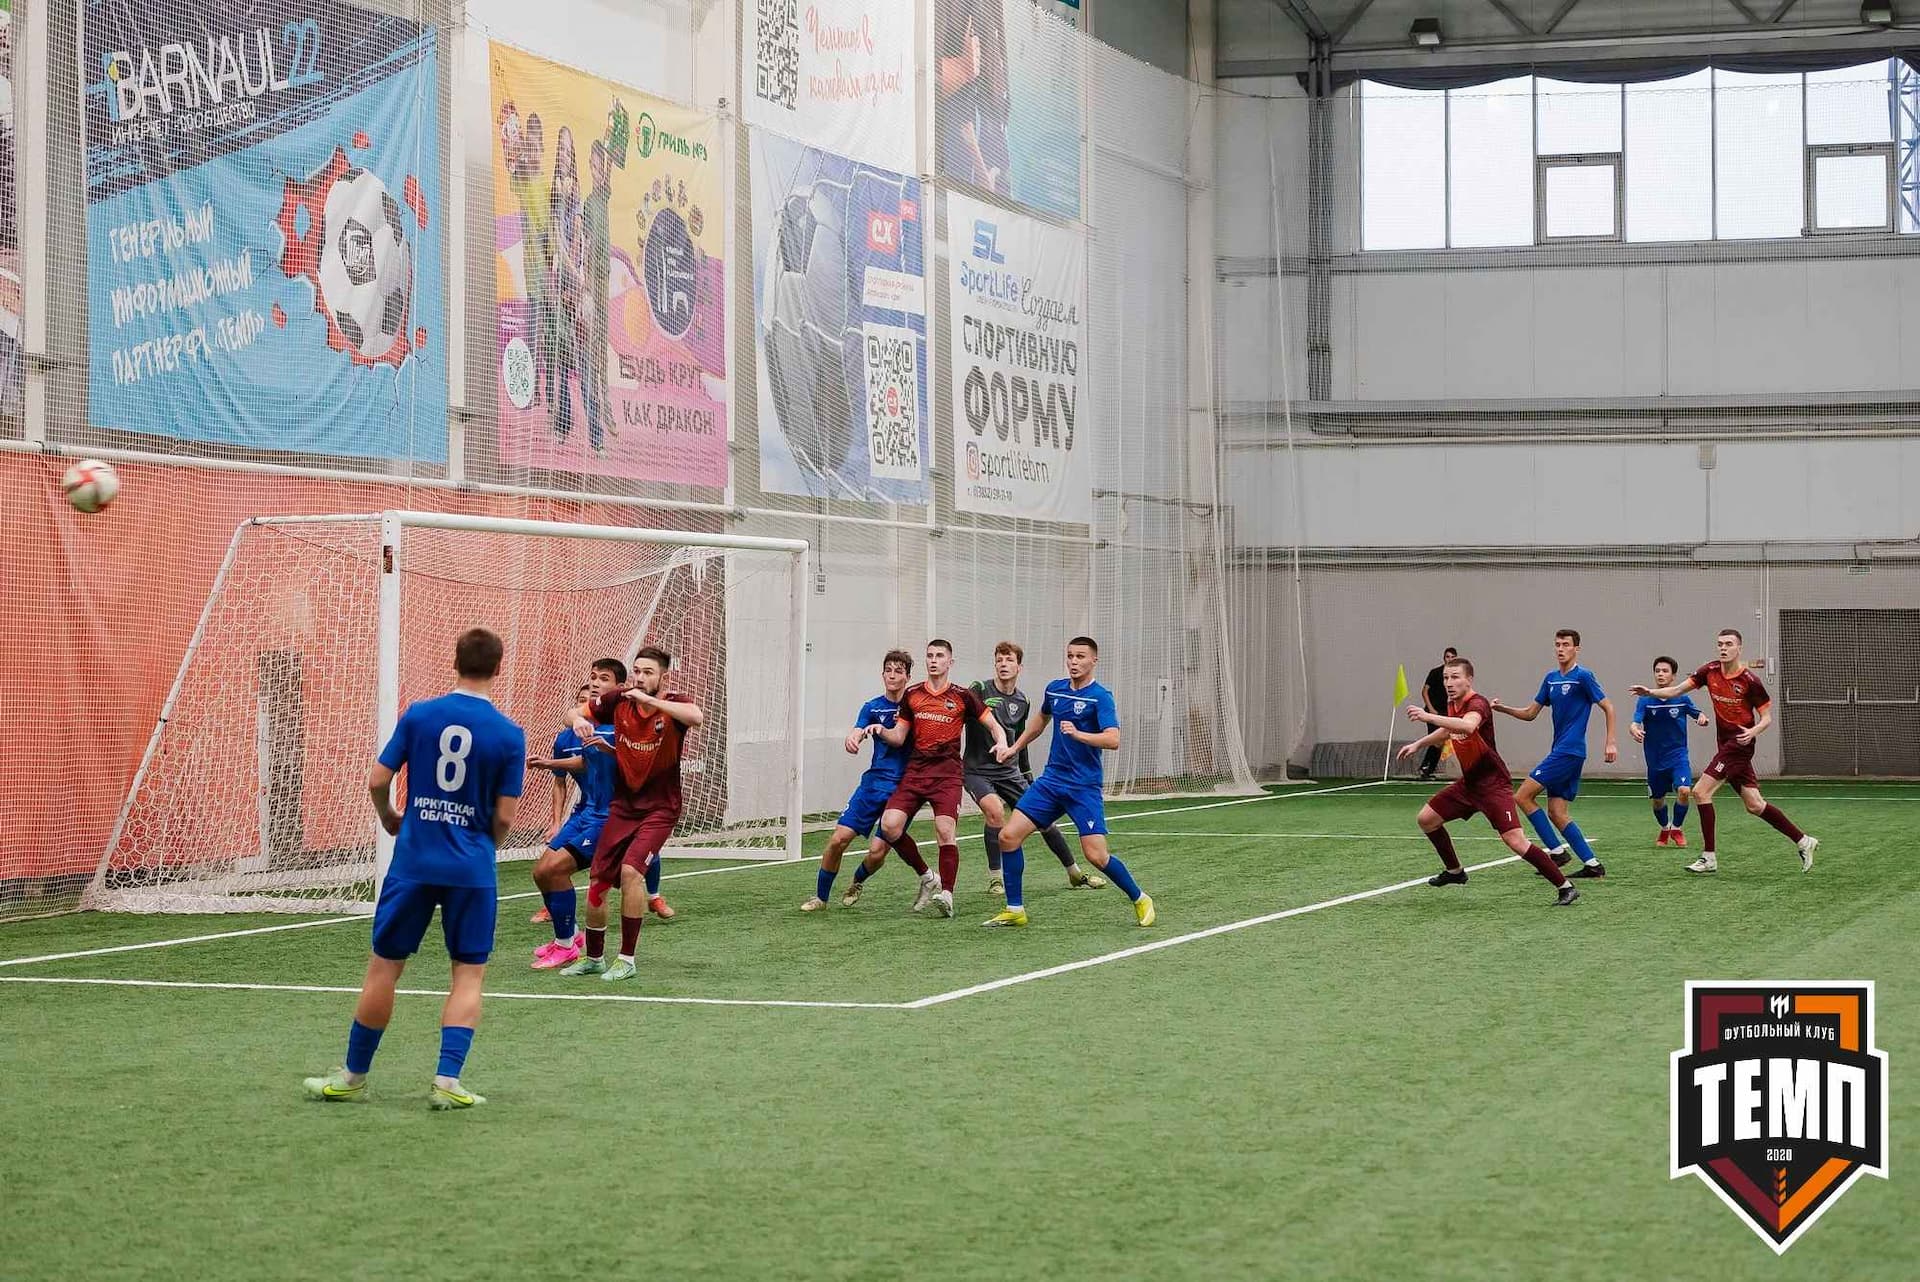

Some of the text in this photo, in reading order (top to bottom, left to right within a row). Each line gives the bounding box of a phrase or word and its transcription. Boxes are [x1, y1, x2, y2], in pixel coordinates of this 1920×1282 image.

[658, 131, 690, 157] ГРИЛЬ
[972, 219, 1005, 264] SL
[960, 261, 1019, 301] SportLife
[112, 334, 183, 386] ПАРТНЕР
[963, 314, 1078, 377] СПОРТИВНУЮ
[619, 353, 666, 388] БУДЬ
[623, 399, 653, 428] КАК
[963, 365, 1077, 451] ФОРМУ
[981, 451, 1050, 484] sportlifebrn
[436, 724, 473, 792] 8
[414, 796, 475, 817] ИРКУТСКАЯ
[420, 809, 469, 827] ОБЛАСТЬ
